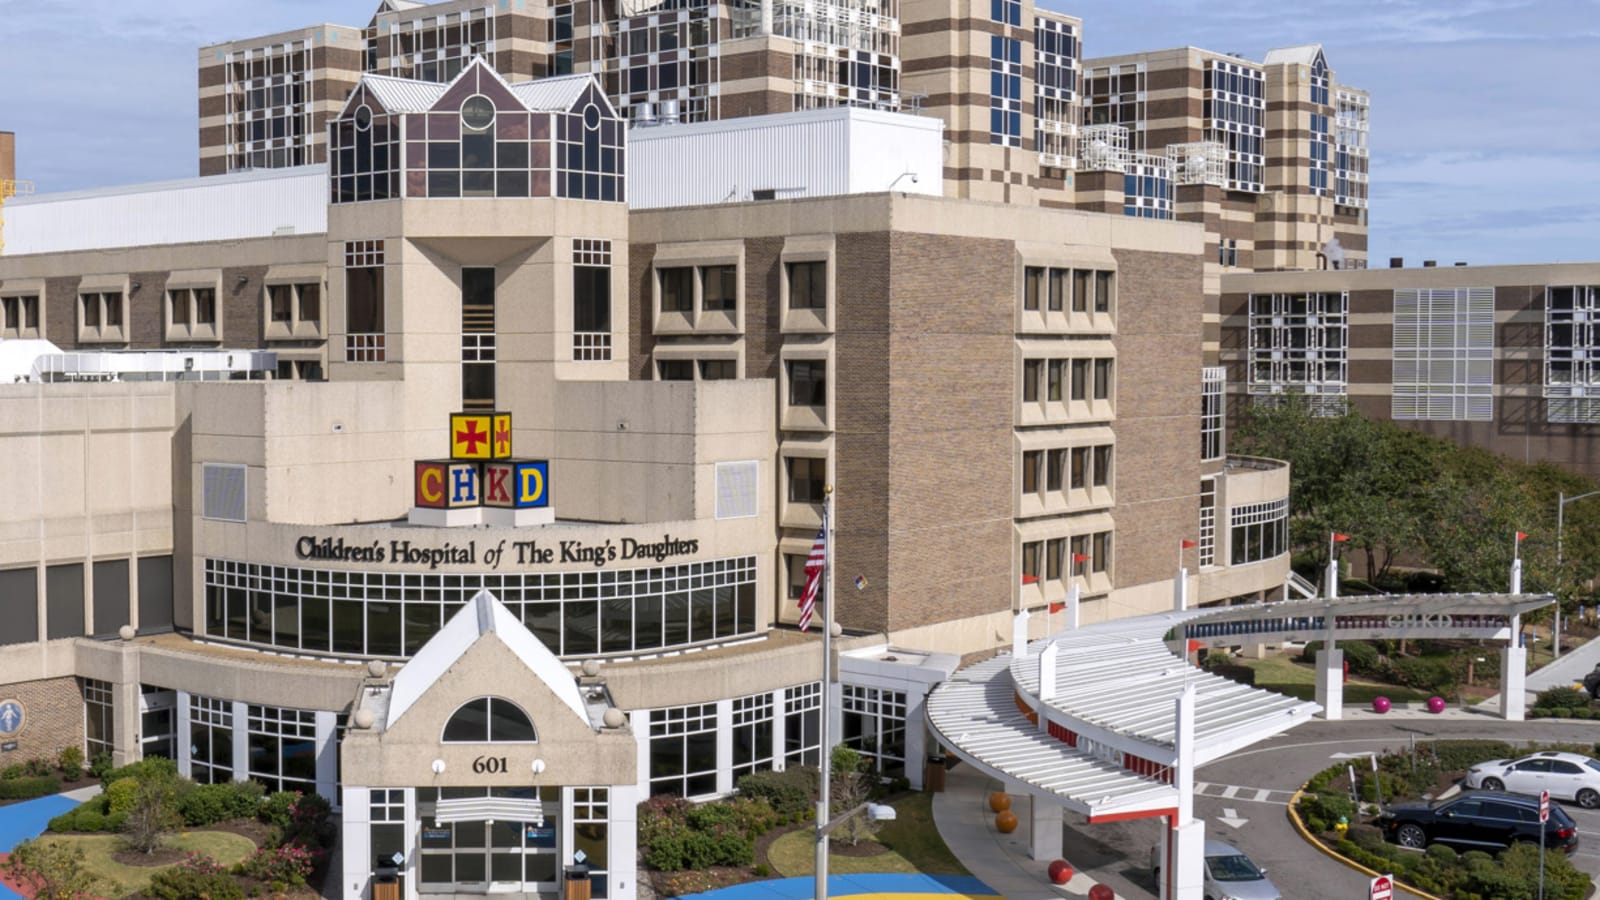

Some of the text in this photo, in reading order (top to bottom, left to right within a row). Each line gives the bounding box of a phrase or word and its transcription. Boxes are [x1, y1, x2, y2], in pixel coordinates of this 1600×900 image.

[420, 467, 543, 502] CHKD
[295, 534, 699, 569] Children's Hospital of The King's Daughters
[472, 755, 508, 774] 601
